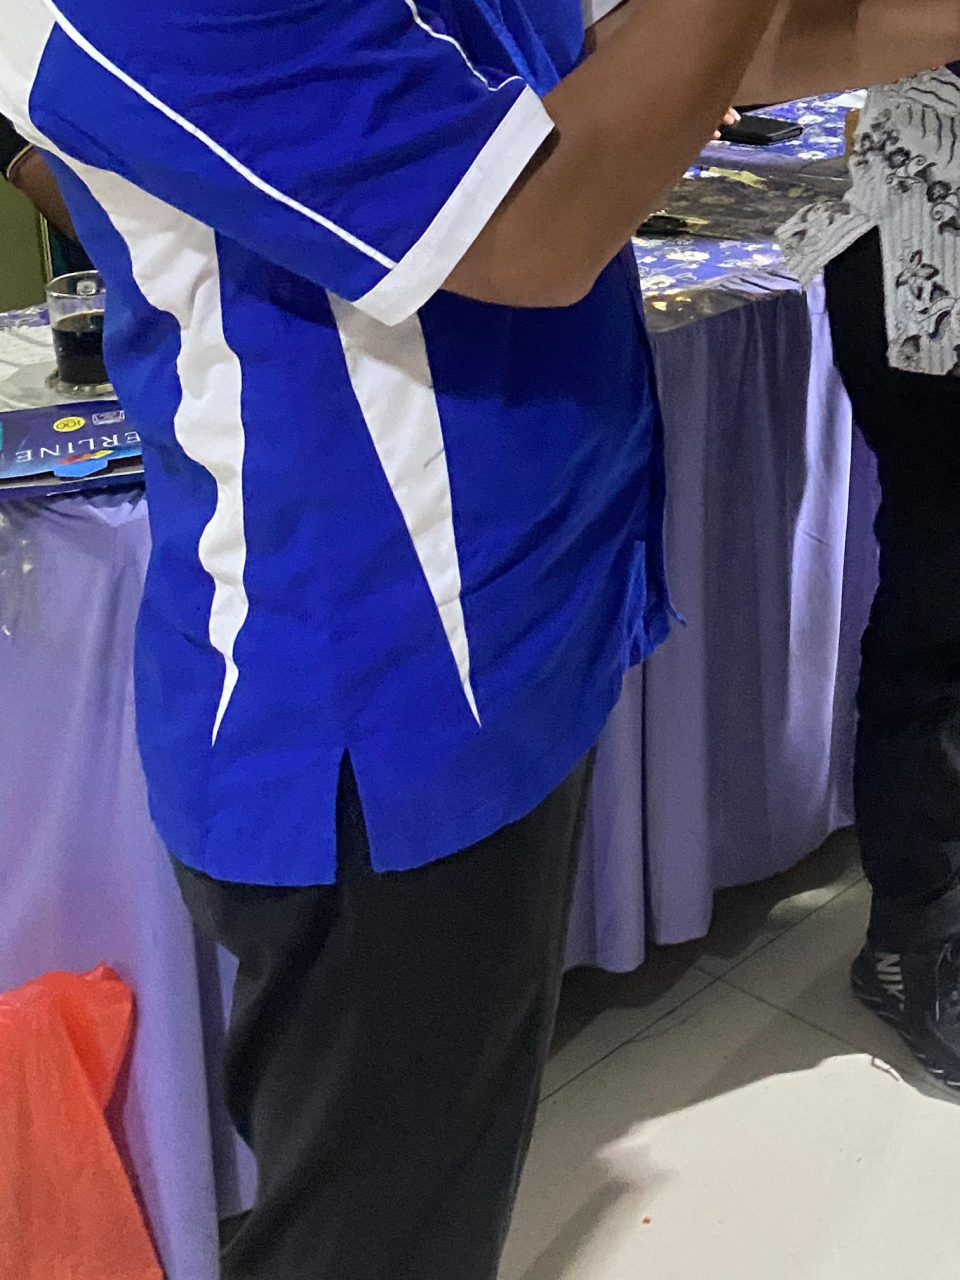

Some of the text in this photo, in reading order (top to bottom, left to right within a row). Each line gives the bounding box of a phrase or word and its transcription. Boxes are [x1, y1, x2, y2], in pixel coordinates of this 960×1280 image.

[55, 419, 82, 431] 100
[15, 431, 141, 463] ERLINE
[876, 953, 905, 1010] NIK
